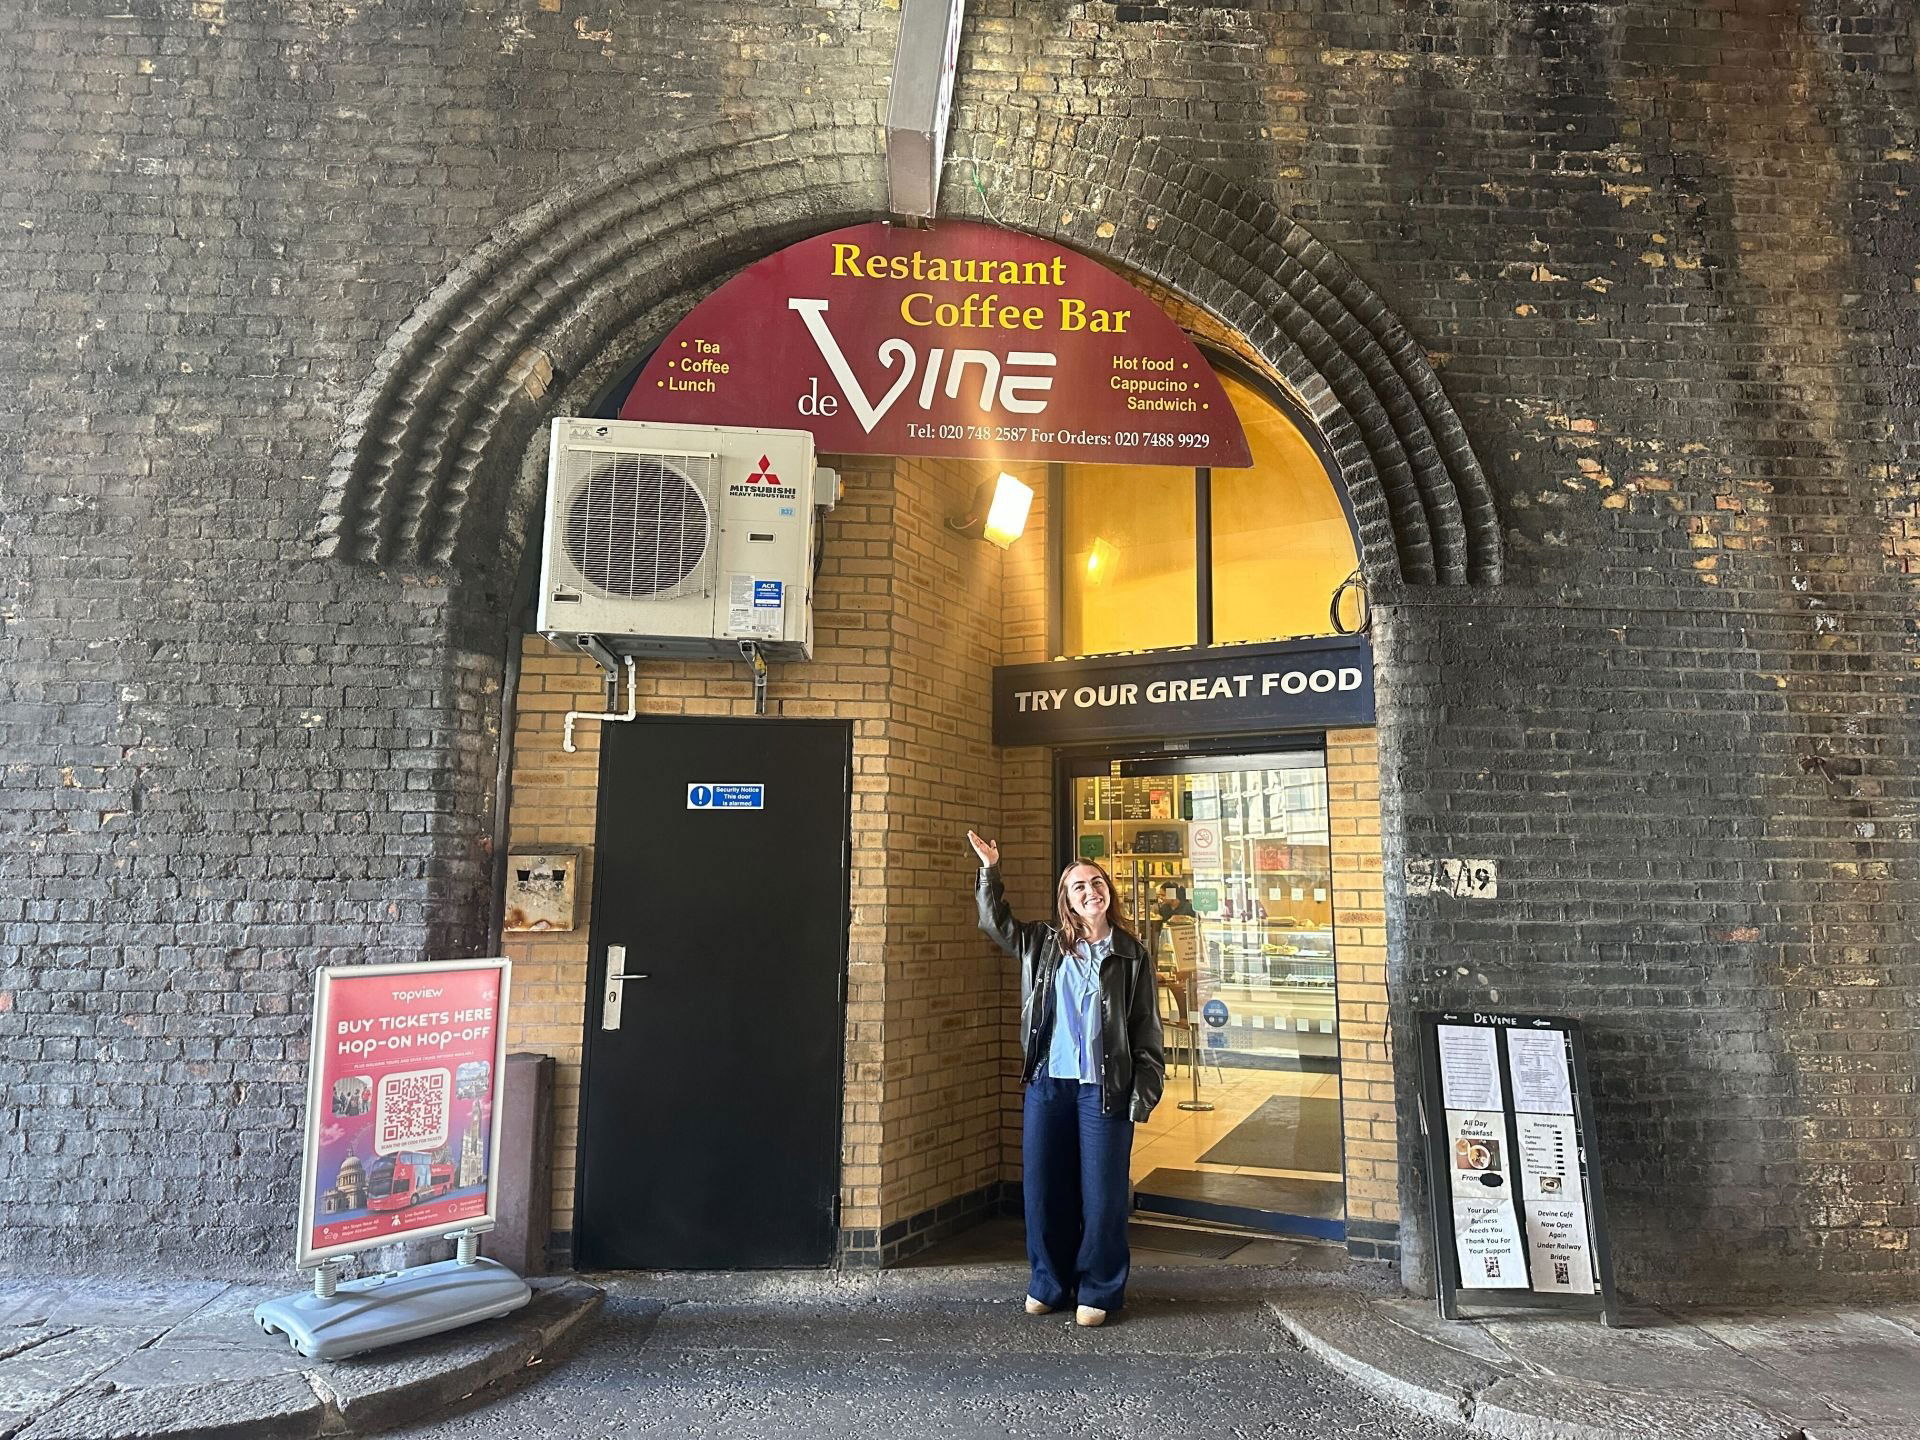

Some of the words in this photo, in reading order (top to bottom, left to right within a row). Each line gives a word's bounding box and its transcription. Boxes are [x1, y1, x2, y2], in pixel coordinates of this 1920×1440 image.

[831, 243, 1067, 286] Restaurant
[900, 292, 1044, 331] Coffee
[1058, 297, 1131, 333] Bar
[695, 339, 720, 354] Tea
[681, 357, 729, 374] Coffee
[1113, 355, 1138, 370] Hot
[1142, 357, 1174, 371] food
[669, 376, 716, 392] Lunch
[1110, 375, 1188, 394] Cappucino
[797, 377, 838, 417] de
[1127, 396, 1197, 412] Sandwich
[907, 423, 935, 439] Tel:
[939, 424, 964, 440] 020
[967, 426, 991, 441] 748
[995, 427, 1027, 442] 2587
[1031, 428, 1054, 443] For
[1057, 429, 1111, 446] Orders:
[1115, 431, 1139, 447] 020
[1143, 432, 1174, 448] 7488
[1178, 433, 1210, 449] 9929
[730, 485, 796, 494] MITSUBISHI
[1014, 688, 1067, 713] TRY
[1073, 682, 1138, 709] OUR
[1145, 674, 1254, 703] GREAT
[1261, 667, 1363, 696] FOOD
[338, 1018, 375, 1035] BUY
[378, 1011, 449, 1031] TICKETS
[454, 1007, 493, 1023] HERE
[338, 1036, 412, 1058] HOP-ON
[416, 1026, 491, 1049] HOP-OFF
